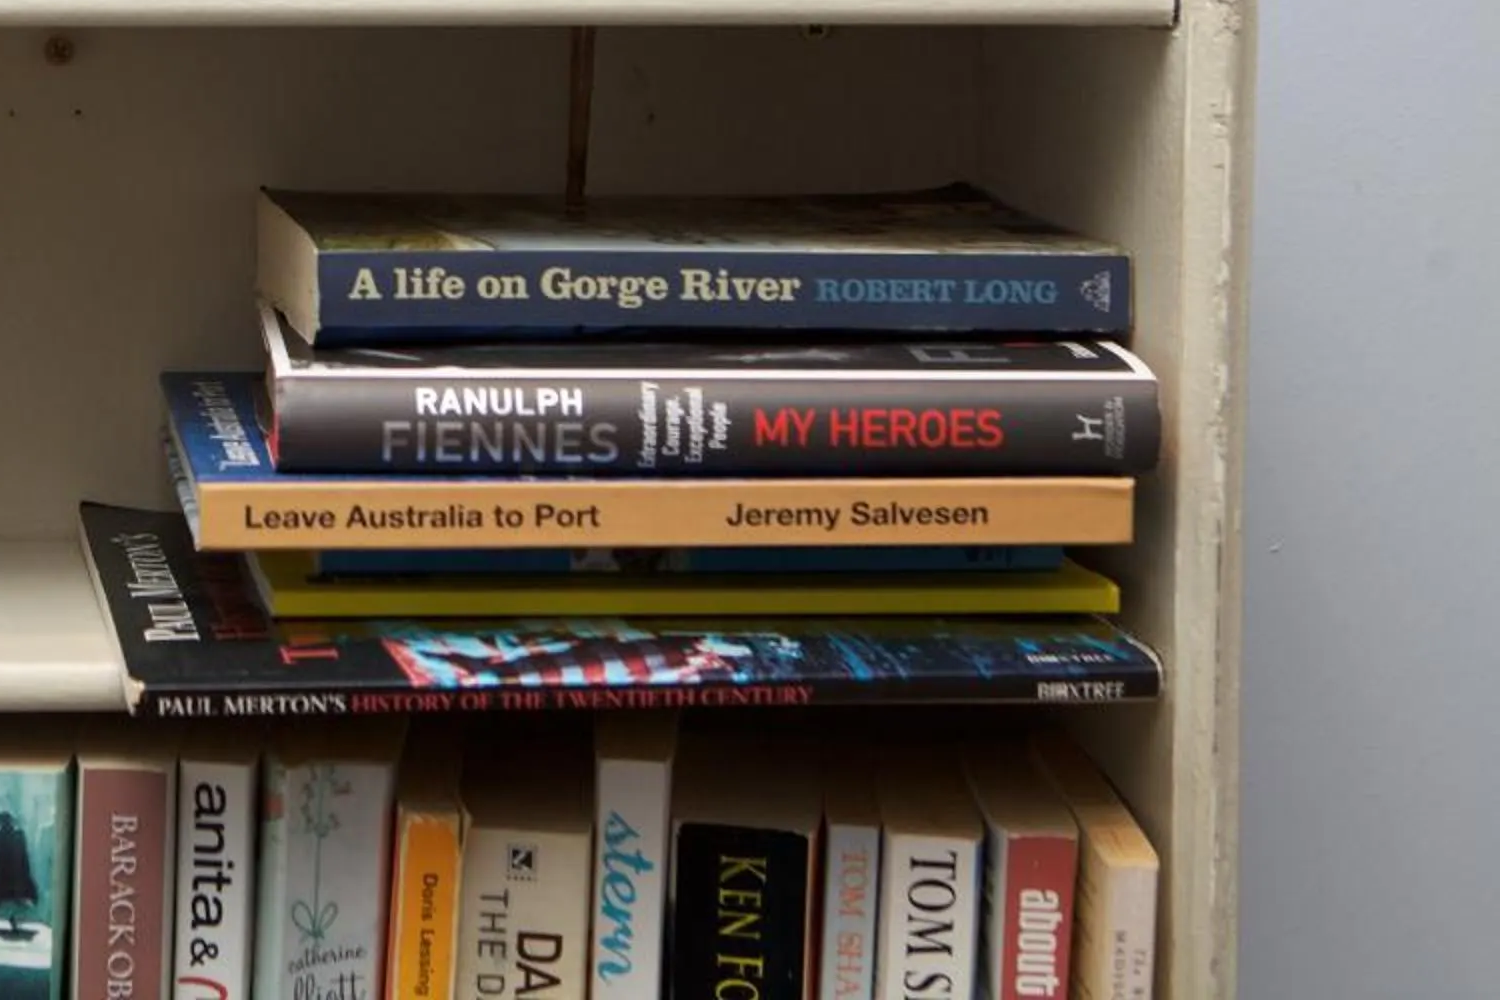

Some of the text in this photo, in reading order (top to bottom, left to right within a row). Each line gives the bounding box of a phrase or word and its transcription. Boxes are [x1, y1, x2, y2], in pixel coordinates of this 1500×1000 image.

[348, 267, 802, 309] A life on Gorge River
[815, 277, 1059, 305] ROBERT LONG
[415, 387, 584, 417] RANULPH
[754, 408, 1005, 449] MY HEROES
[382, 420, 620, 463] FIENNES
[244, 503, 601, 529] Leave Australia to Port
[726, 500, 989, 532] Jeremy Salvesen
[157, 684, 814, 717] PAUL MERTON'S HISTORY OF THE TWENTIETH CENTURY
[190, 781, 235, 930] anita
[838, 849, 868, 917] TOM
[107, 812, 139, 1000] BARACK OB
[717, 854, 768, 941] KEN
[902, 850, 958, 1000] TOM S
[190, 938, 220, 966] &
[414, 872, 438, 997] Doris Lessing
[476, 888, 510, 1000] THE D
[1015, 888, 1064, 998] about
[514, 931, 564, 1000] DA
